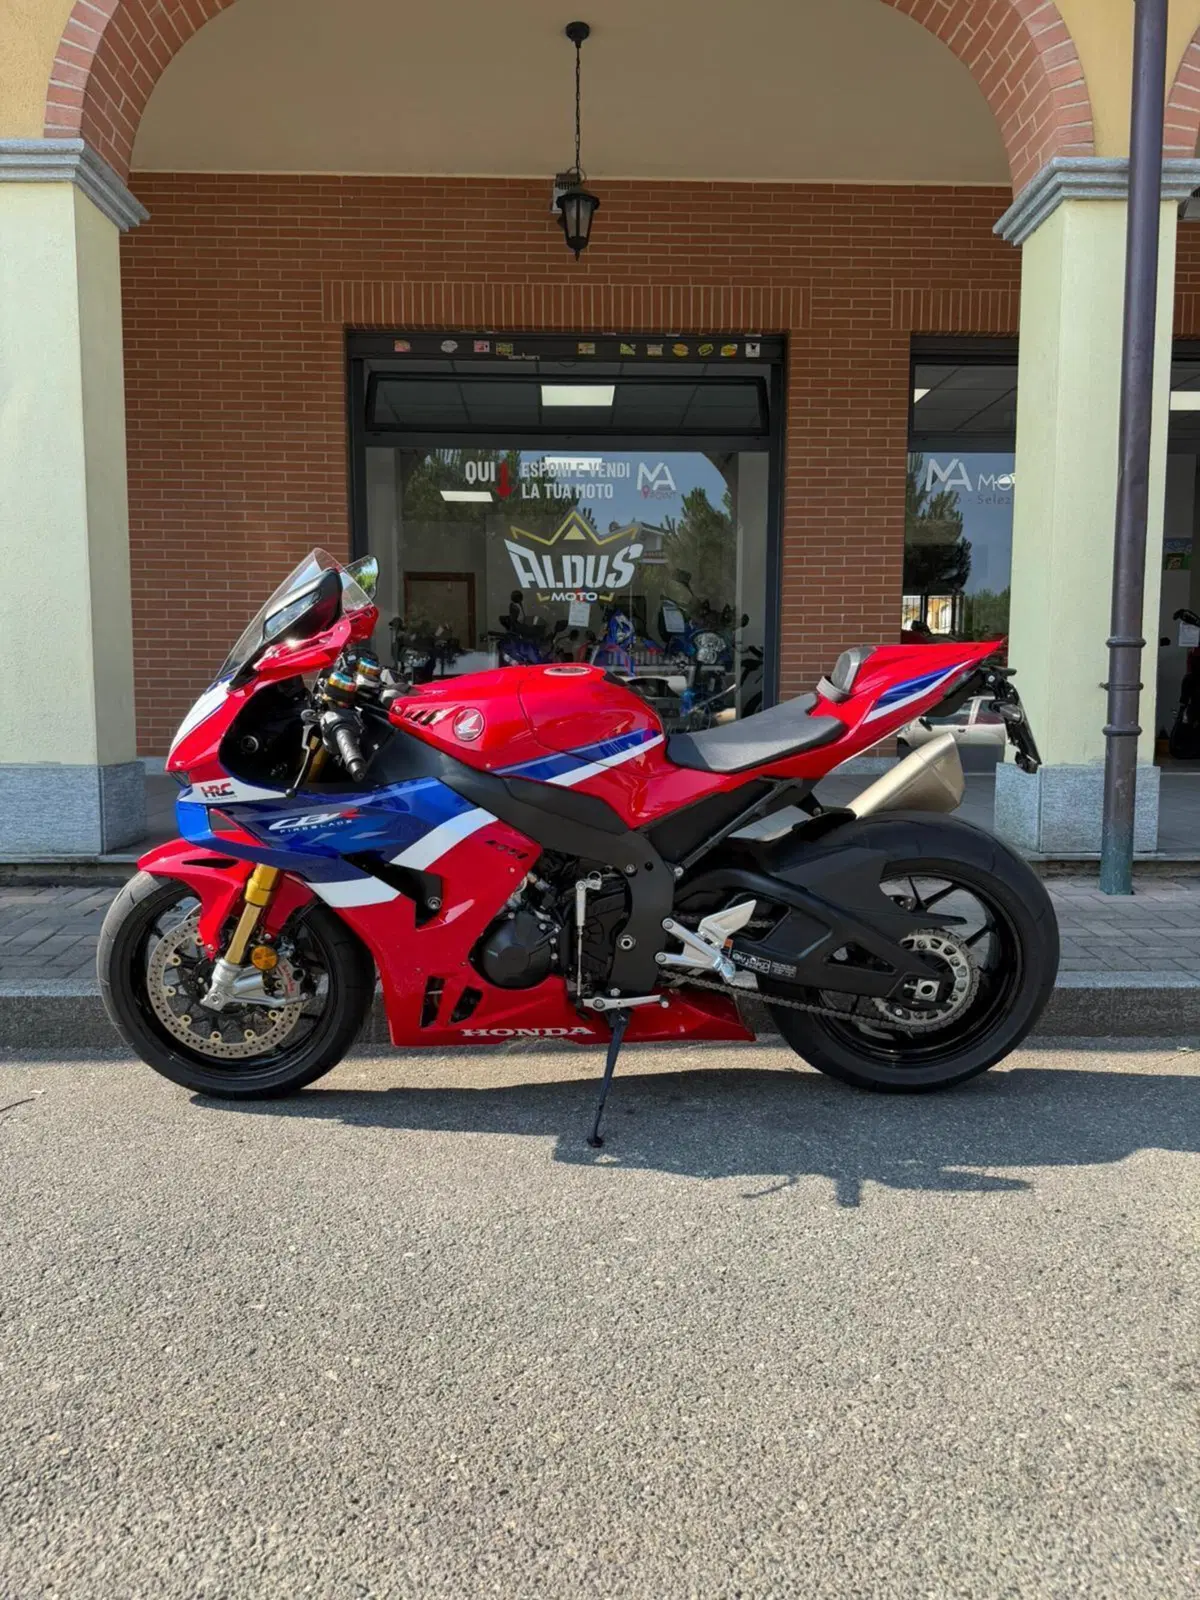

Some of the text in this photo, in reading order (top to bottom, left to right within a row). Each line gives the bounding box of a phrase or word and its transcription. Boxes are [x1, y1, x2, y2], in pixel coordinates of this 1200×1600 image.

[465, 461, 496, 484] QUI
[521, 462, 630, 478] ESPONI E VENDI
[636, 462, 677, 491] MA
[925, 458, 973, 491] MA
[521, 483, 614, 499] LA TUA MOTO
[503, 538, 644, 589] ALDUS
[551, 592, 598, 601] MOTO
[200, 783, 235, 798] HRC
[460, 1026, 597, 1036] HONDA
